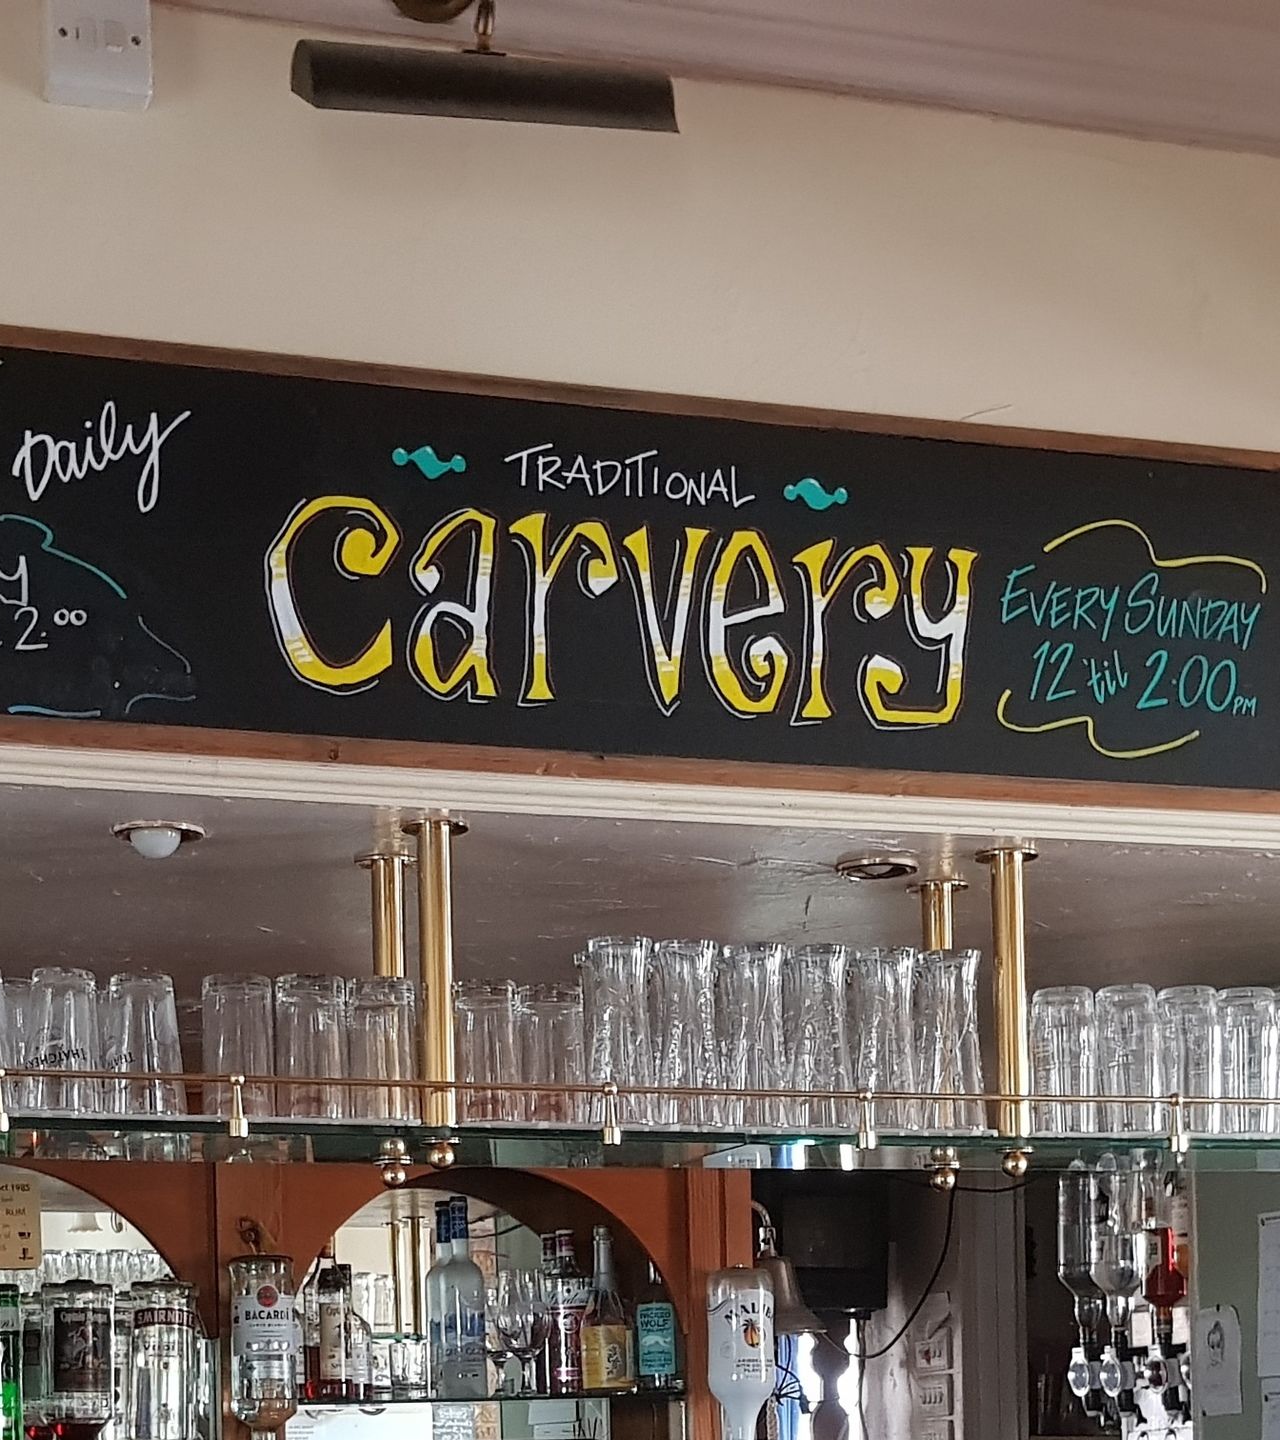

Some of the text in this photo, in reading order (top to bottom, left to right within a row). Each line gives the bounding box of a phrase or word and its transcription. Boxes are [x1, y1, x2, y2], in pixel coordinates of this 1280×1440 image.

[12, 401, 191, 513] Daily
[504, 444, 756, 508] TRADITIONAL
[265, 496, 980, 729] Carvery
[1000, 564, 1261, 651] EVERY SUNDAY
[1030, 640, 1077, 702] 12
[5, 1207, 26, 1216] RUM
[724, 1302, 774, 1326] MALIB
